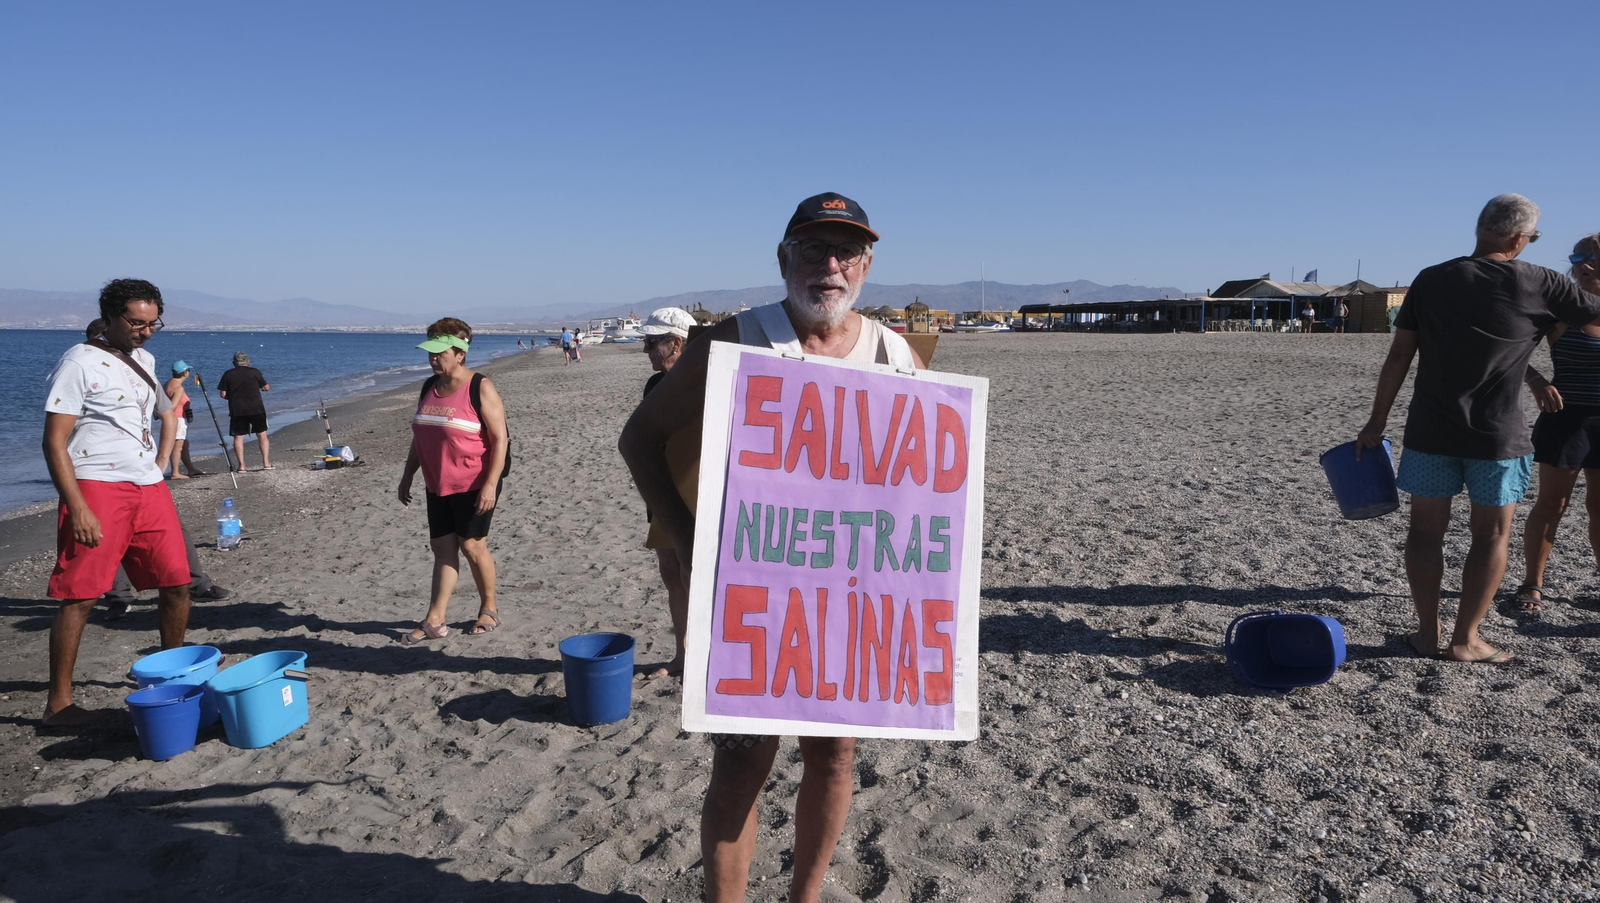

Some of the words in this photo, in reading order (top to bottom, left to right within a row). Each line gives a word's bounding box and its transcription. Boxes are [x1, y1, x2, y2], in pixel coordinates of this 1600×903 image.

[420, 405, 456, 417] SUNSHINE
[738, 374, 968, 493] SALVAD
[733, 499, 952, 573] NUESTRAS
